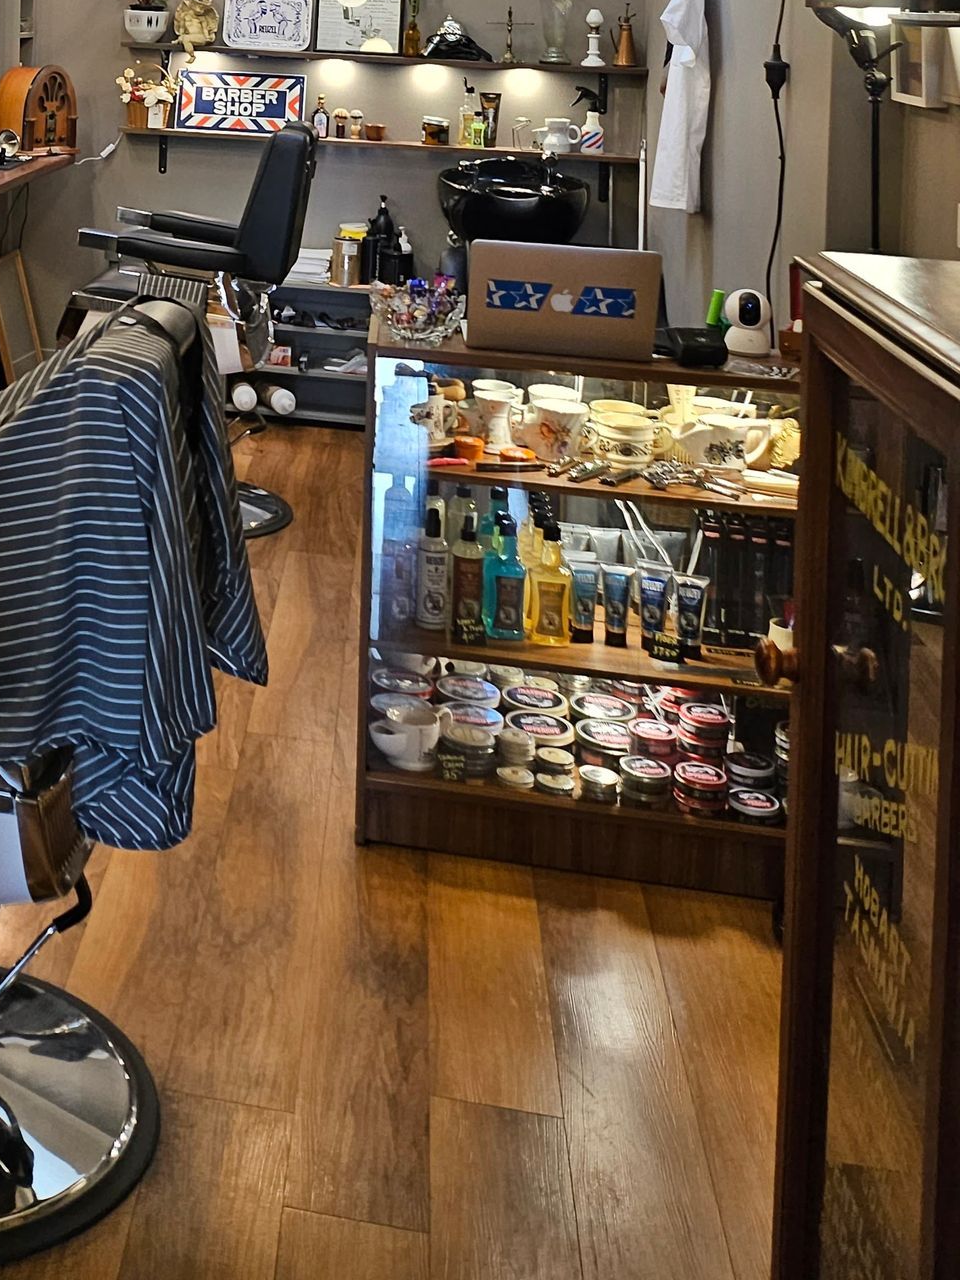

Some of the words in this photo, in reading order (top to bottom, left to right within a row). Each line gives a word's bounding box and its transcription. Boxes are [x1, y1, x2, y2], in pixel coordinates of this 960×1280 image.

[201, 86, 279, 105] BARBER
[213, 100, 266, 118] SHOP
[873, 564, 908, 633] LTD.
[853, 852, 913, 987] HOBART
[843, 879, 916, 1064] TASMANIA
